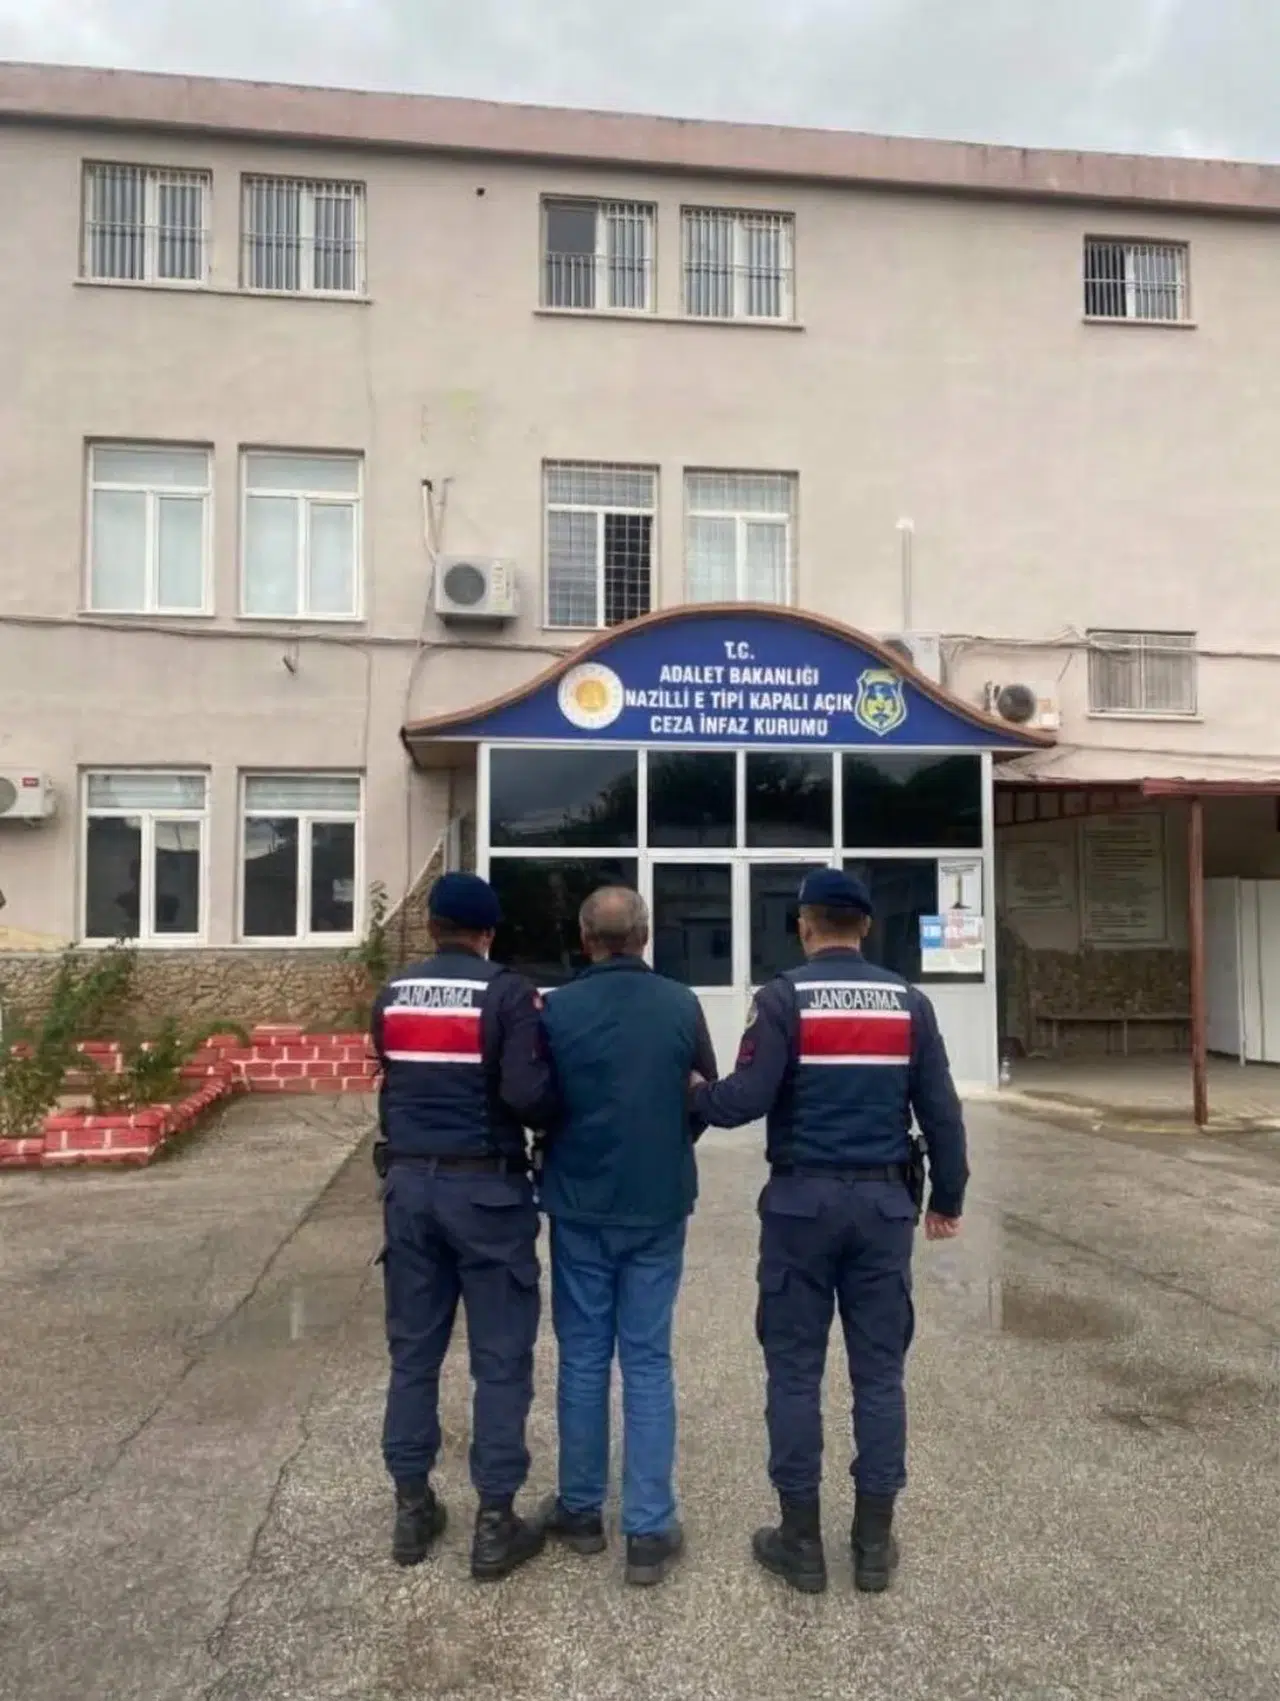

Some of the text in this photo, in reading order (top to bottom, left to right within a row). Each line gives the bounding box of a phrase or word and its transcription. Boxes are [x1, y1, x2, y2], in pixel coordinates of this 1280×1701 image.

[724, 641, 755, 660] T.C.
[660, 665, 819, 686] ADALET BAKANLIĞI
[625, 686, 854, 715] NAZİLLİ E TİPİ KAPALI AÇIK
[650, 713, 828, 736] CEZA İNFAZ KURUMU
[810, 987, 900, 1010] JANDARMA
